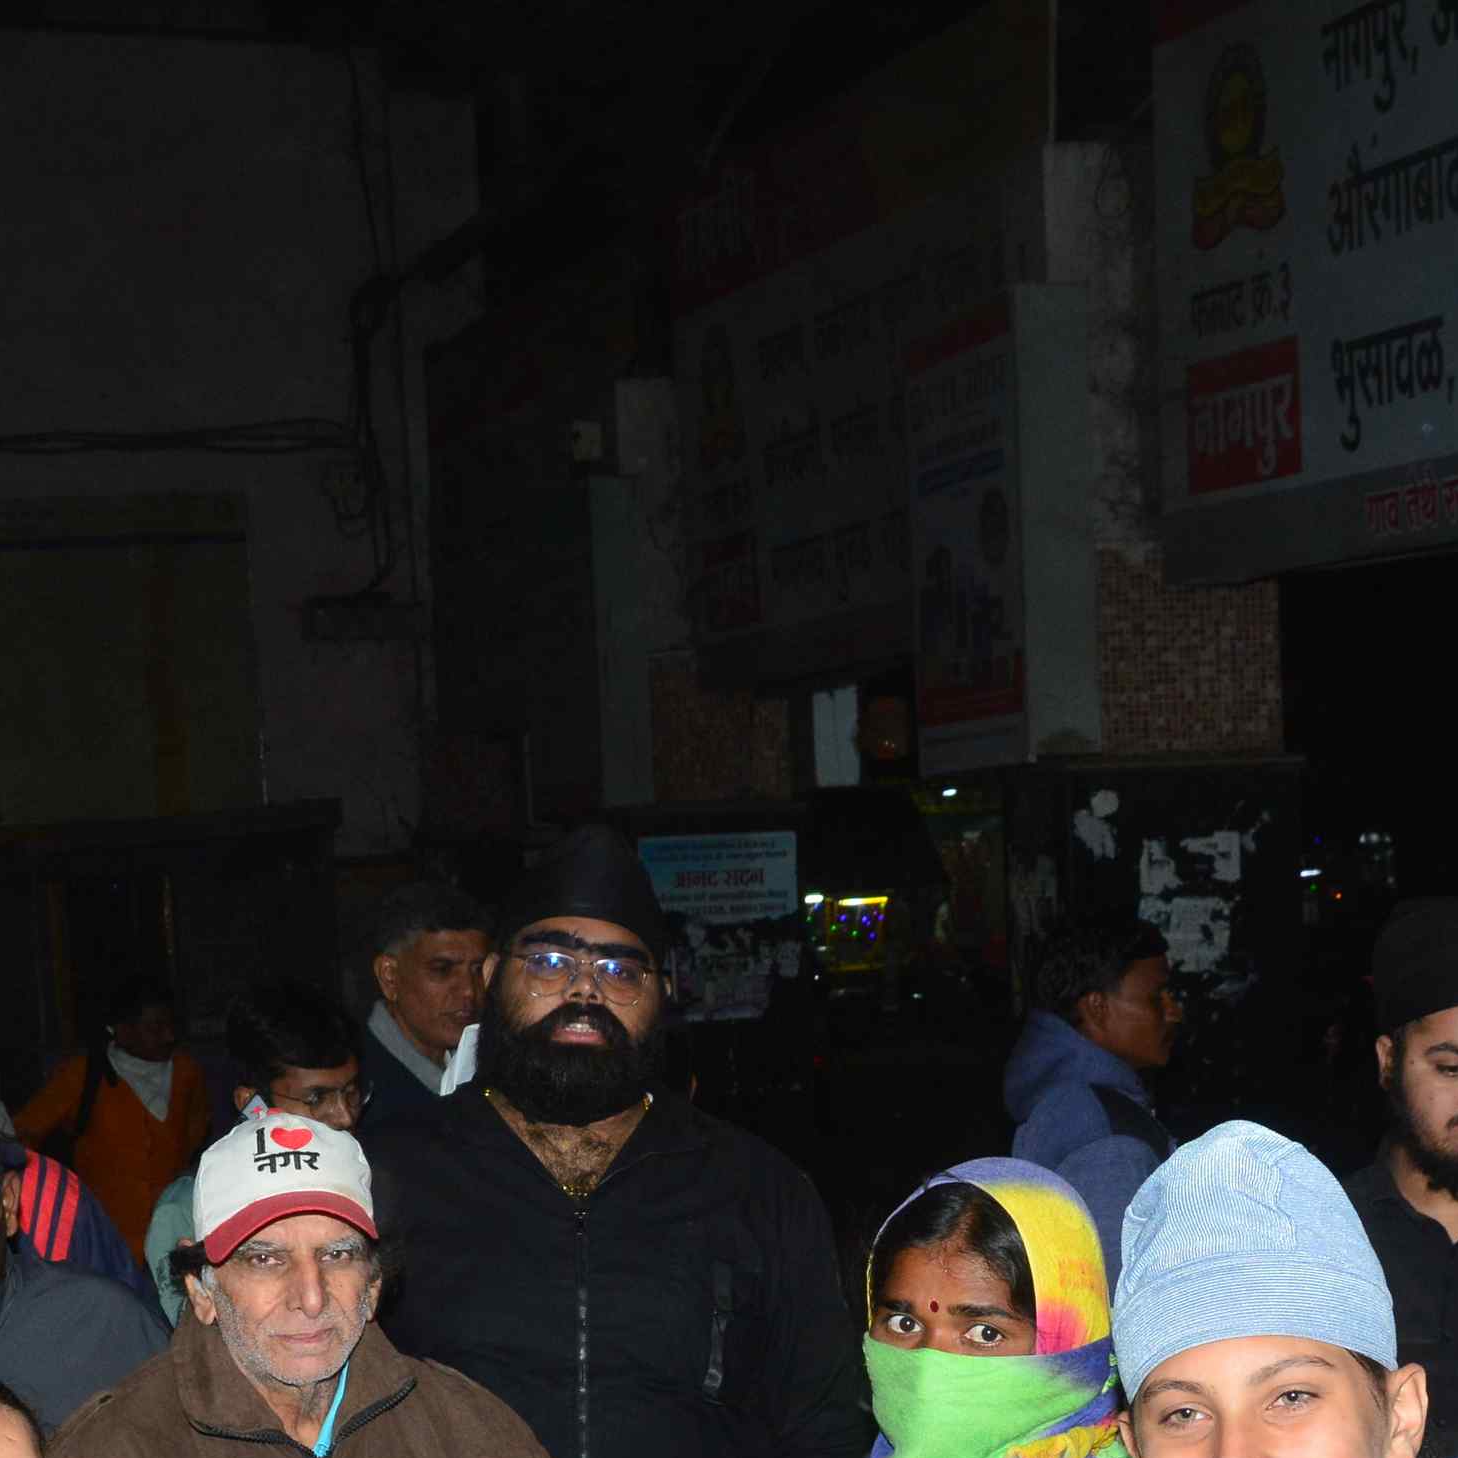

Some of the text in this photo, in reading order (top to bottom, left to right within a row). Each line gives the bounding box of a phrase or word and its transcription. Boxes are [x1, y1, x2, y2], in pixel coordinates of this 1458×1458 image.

[1330, 315, 1454, 452] भुसावळ,
[256, 1127, 266, 1153] I
[254, 1150, 320, 1173] नगर
